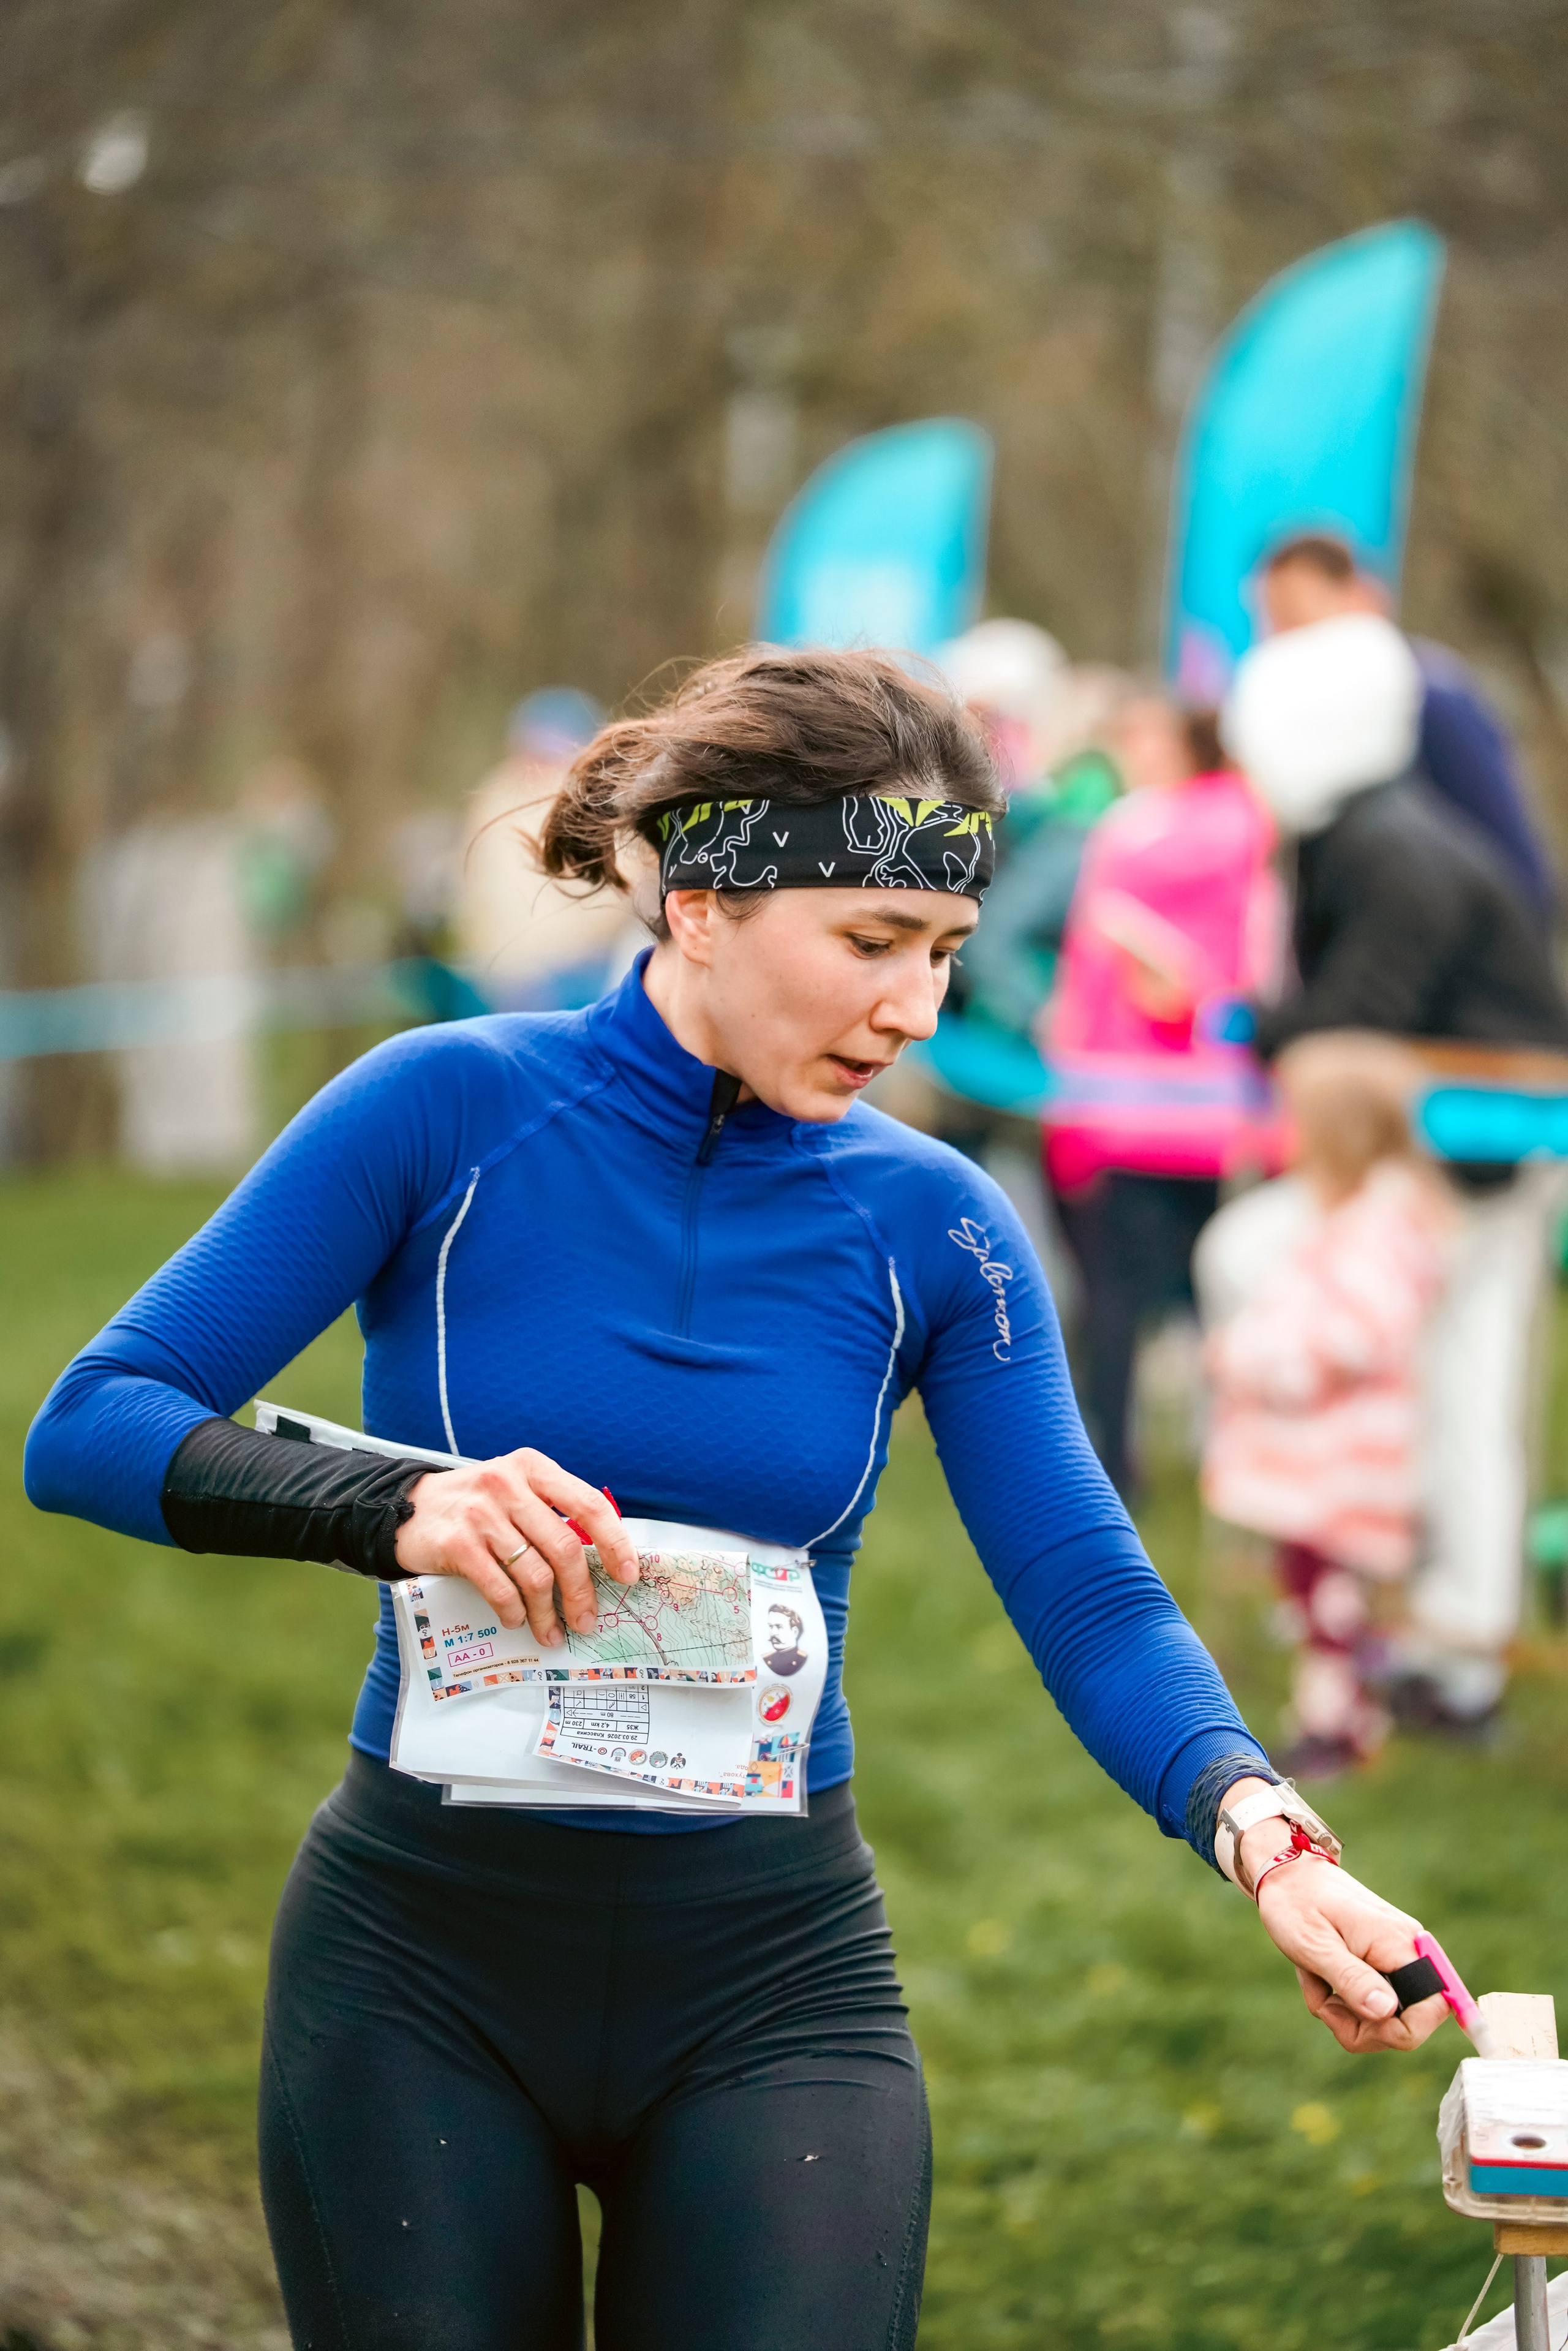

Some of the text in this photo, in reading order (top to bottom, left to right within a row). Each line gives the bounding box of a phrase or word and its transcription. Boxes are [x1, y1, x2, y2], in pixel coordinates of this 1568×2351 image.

[458, 1633, 473, 1643] 1:7
[478, 1626, 497, 1638] 500
[473, 1662, 503, 1672] организаторов
